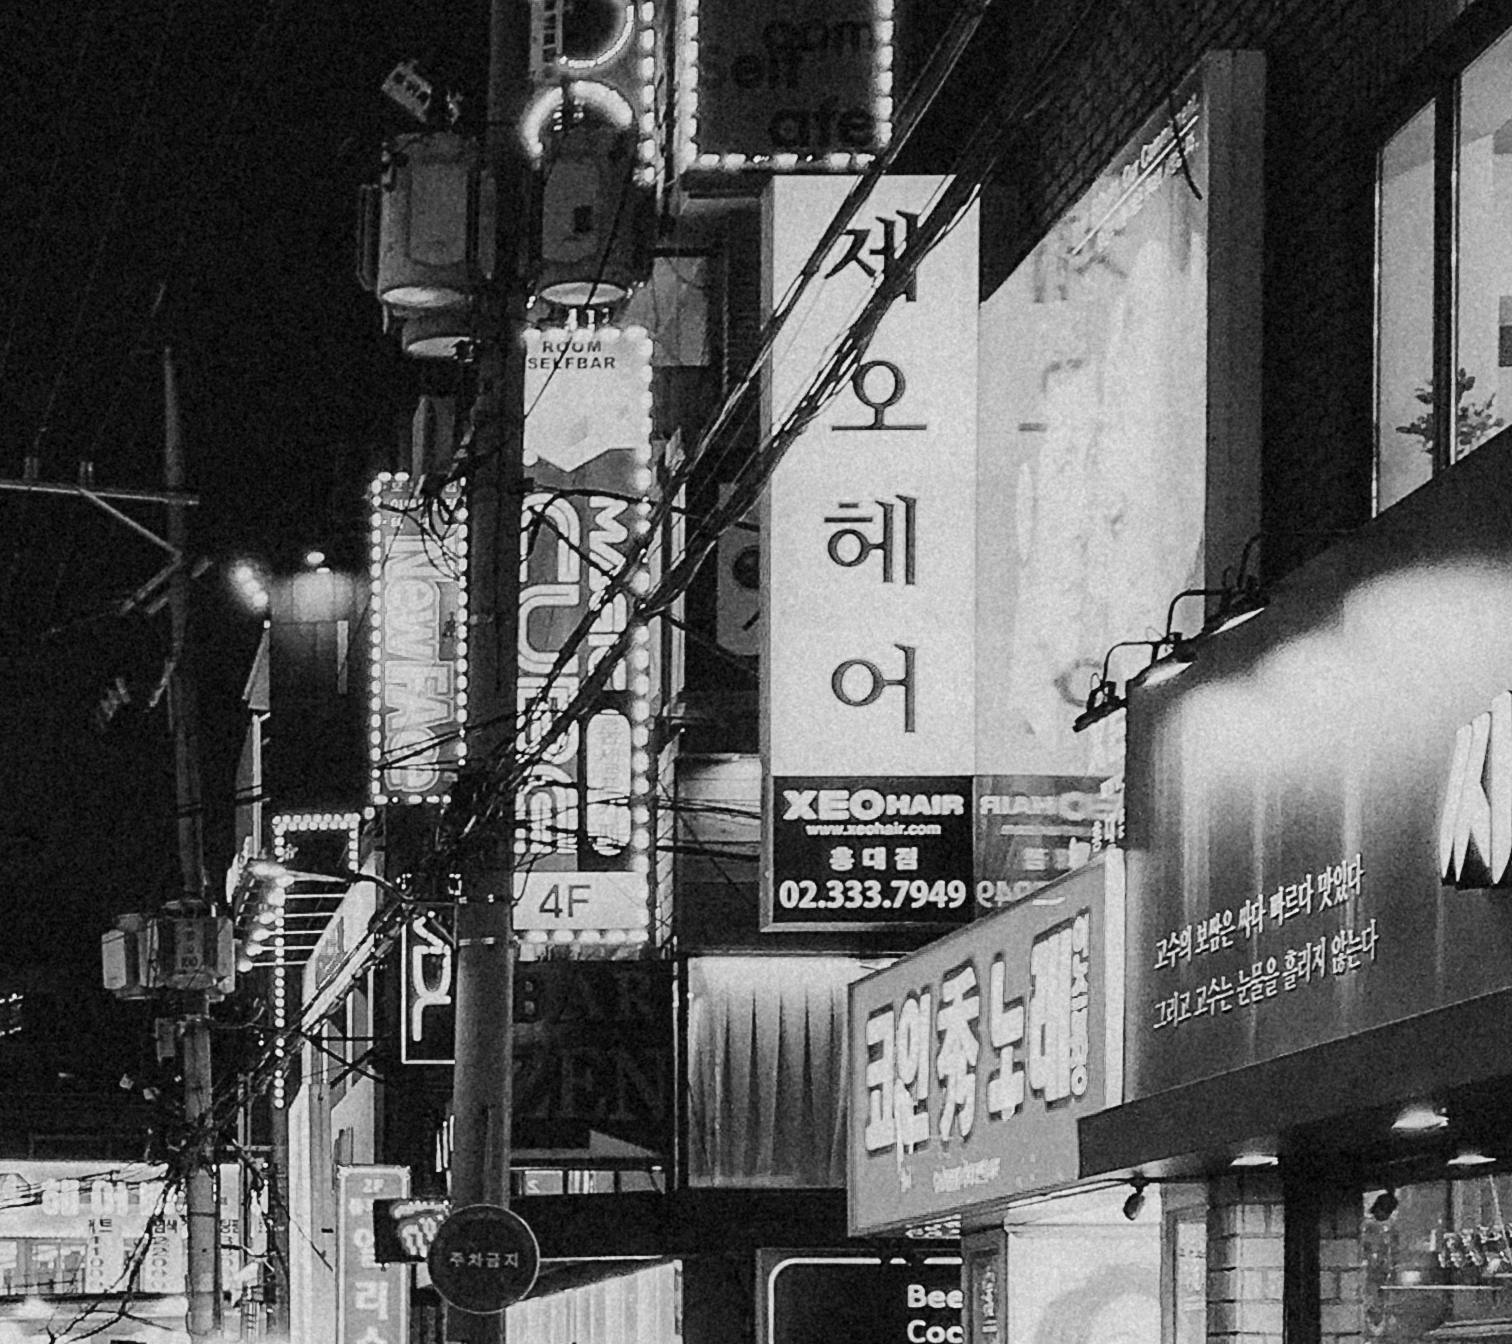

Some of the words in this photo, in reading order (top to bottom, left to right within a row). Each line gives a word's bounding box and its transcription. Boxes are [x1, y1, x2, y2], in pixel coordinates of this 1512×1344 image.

[541, 340, 602, 354] ROOM
[527, 356, 617, 370] SELFBAR
[824, 208, 928, 735] 제오헤어
[805, 822, 942, 836] www.xeohair.com
[828, 845, 919, 871] 홍대점
[538, 884, 592, 920] 4F
[779, 879, 967, 909] 02.333.7949
[1153, 925, 1192, 970] 고수의
[1195, 908, 1237, 955] 보쌈은
[1238, 893, 1266, 938] 싸다
[1269, 873, 1316, 926] 빠르다
[1317, 852, 1367, 912] 맛있다
[1153, 991, 1192, 1029] 그리고
[1194, 975, 1236, 1016] 고수는
[1236, 955, 1281, 1006] 눈물을
[1282, 935, 1327, 992] 흘리지
[1330, 918, 1380, 976] 않는다
[448, 1251, 519, 1269] 주차금지
